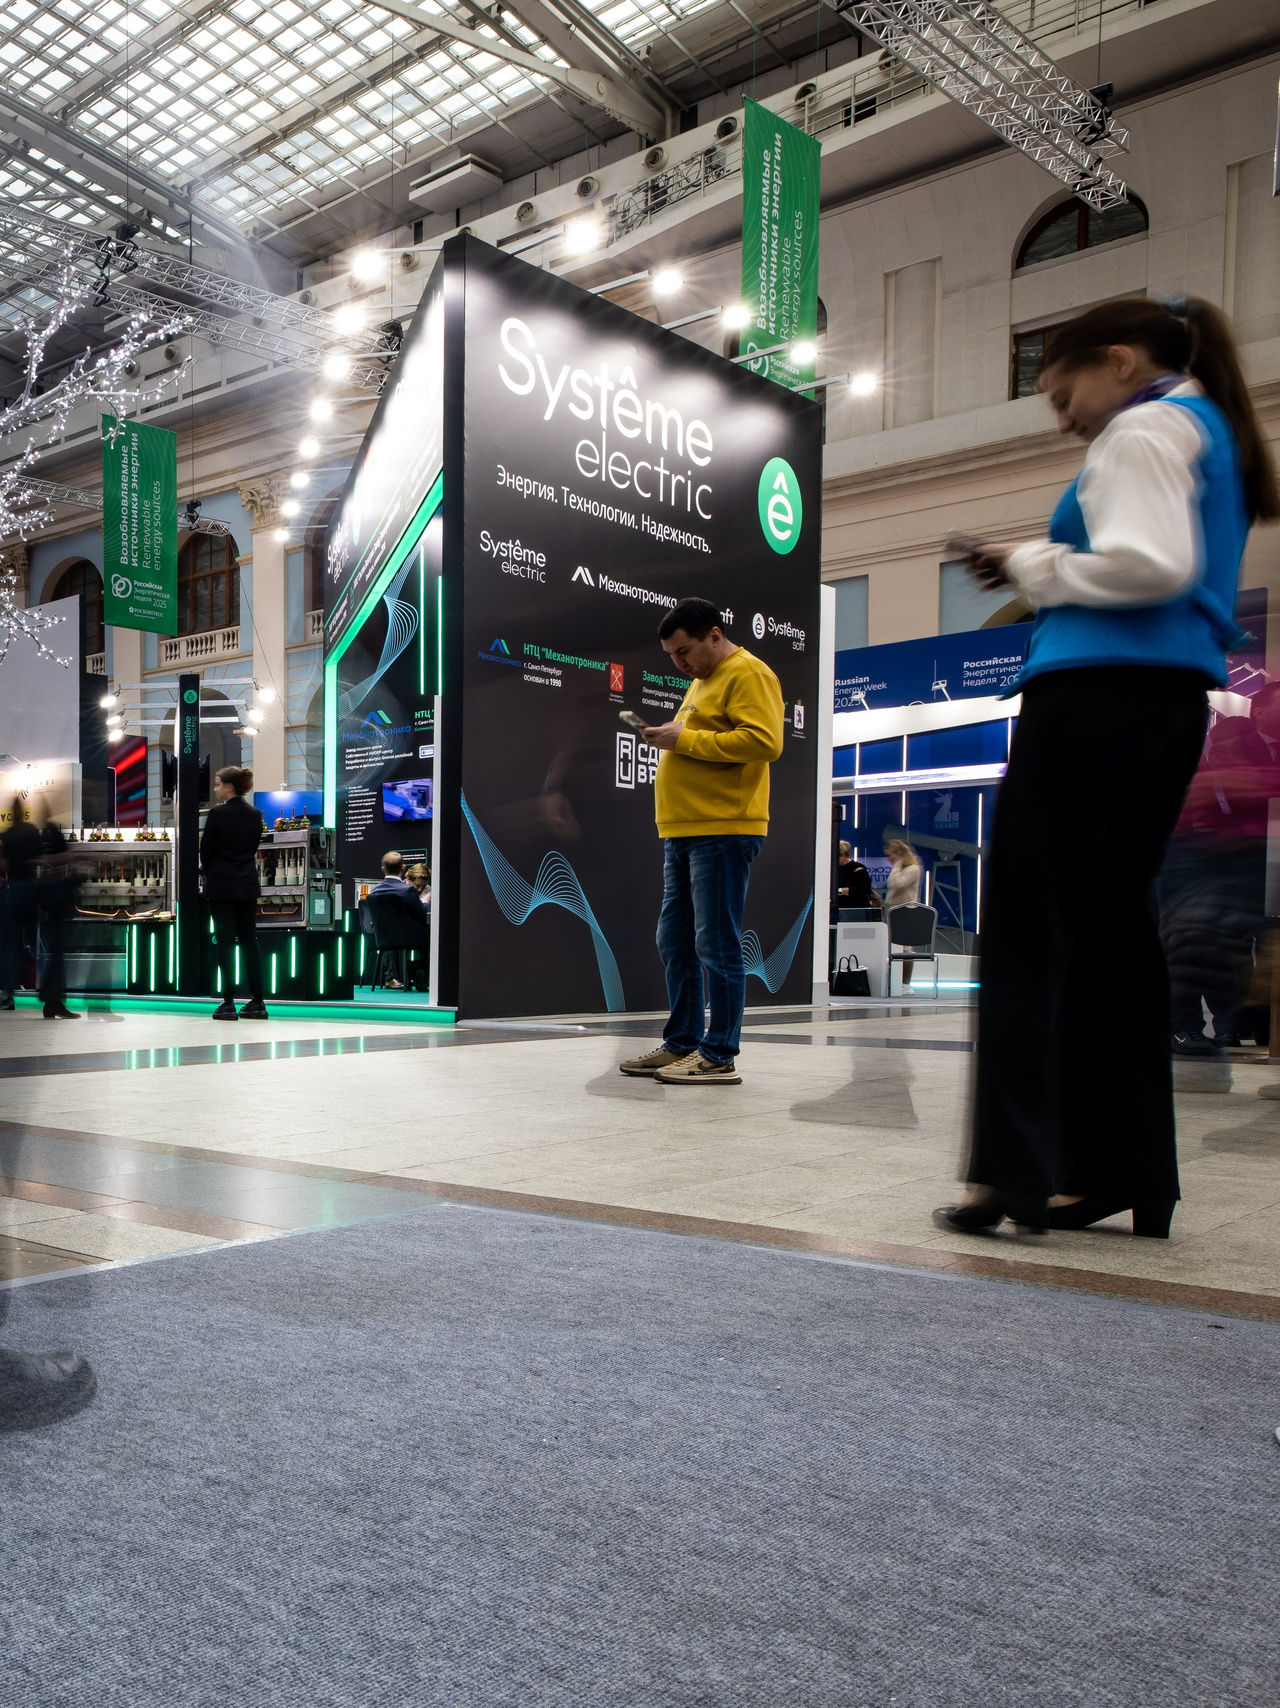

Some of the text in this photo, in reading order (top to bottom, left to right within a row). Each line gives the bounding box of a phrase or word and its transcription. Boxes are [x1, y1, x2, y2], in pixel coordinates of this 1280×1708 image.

[757, 149, 771, 331] Возобновляемые
[769, 132, 783, 336] источники энергии
[792, 210, 803, 347] energy sources
[779, 237, 792, 341] Renewable
[770, 355, 800, 375] Российская
[770, 365, 809, 385] Энергетическа
[498, 317, 713, 467] Systême
[575, 431, 713, 520] electric
[120, 445, 129, 565] Возобновляемые
[131, 432, 140, 567] источники энергии
[496, 464, 712, 554] Энергия. Технологии. Надежность.
[142, 500, 151, 569] Renewable
[152, 480, 163, 571] energy sources
[480, 530, 546, 567] Systême
[501, 558, 546, 583] electric
[134, 580, 163, 591] Российская
[134, 587, 171, 599] Энергетическая
[598, 573, 678, 609] Механотроника
[134, 594, 167, 609] Неделя 2025
[768, 617, 805, 641] Systême
[523, 643, 540, 660] НТЦ
[792, 639, 805, 652] soft
[477, 651, 522, 668] Механотроника
[527, 662, 563, 676] Санкт-Петербург
[963, 654, 1022, 669] Российская
[523, 674, 545, 684] основан
[550, 678, 562, 688] 1990
[642, 670, 663, 687] Завод
[834, 675, 869, 687] Russian
[963, 675, 997, 687] Неделя
[834, 681, 888, 697] Energy Week
[642, 698, 660, 707] основан
[663, 701, 674, 710] 2010
[414, 710, 431, 719] НТЦ
[183, 715, 192, 754] Systême
[342, 725, 412, 742] Механотроника
